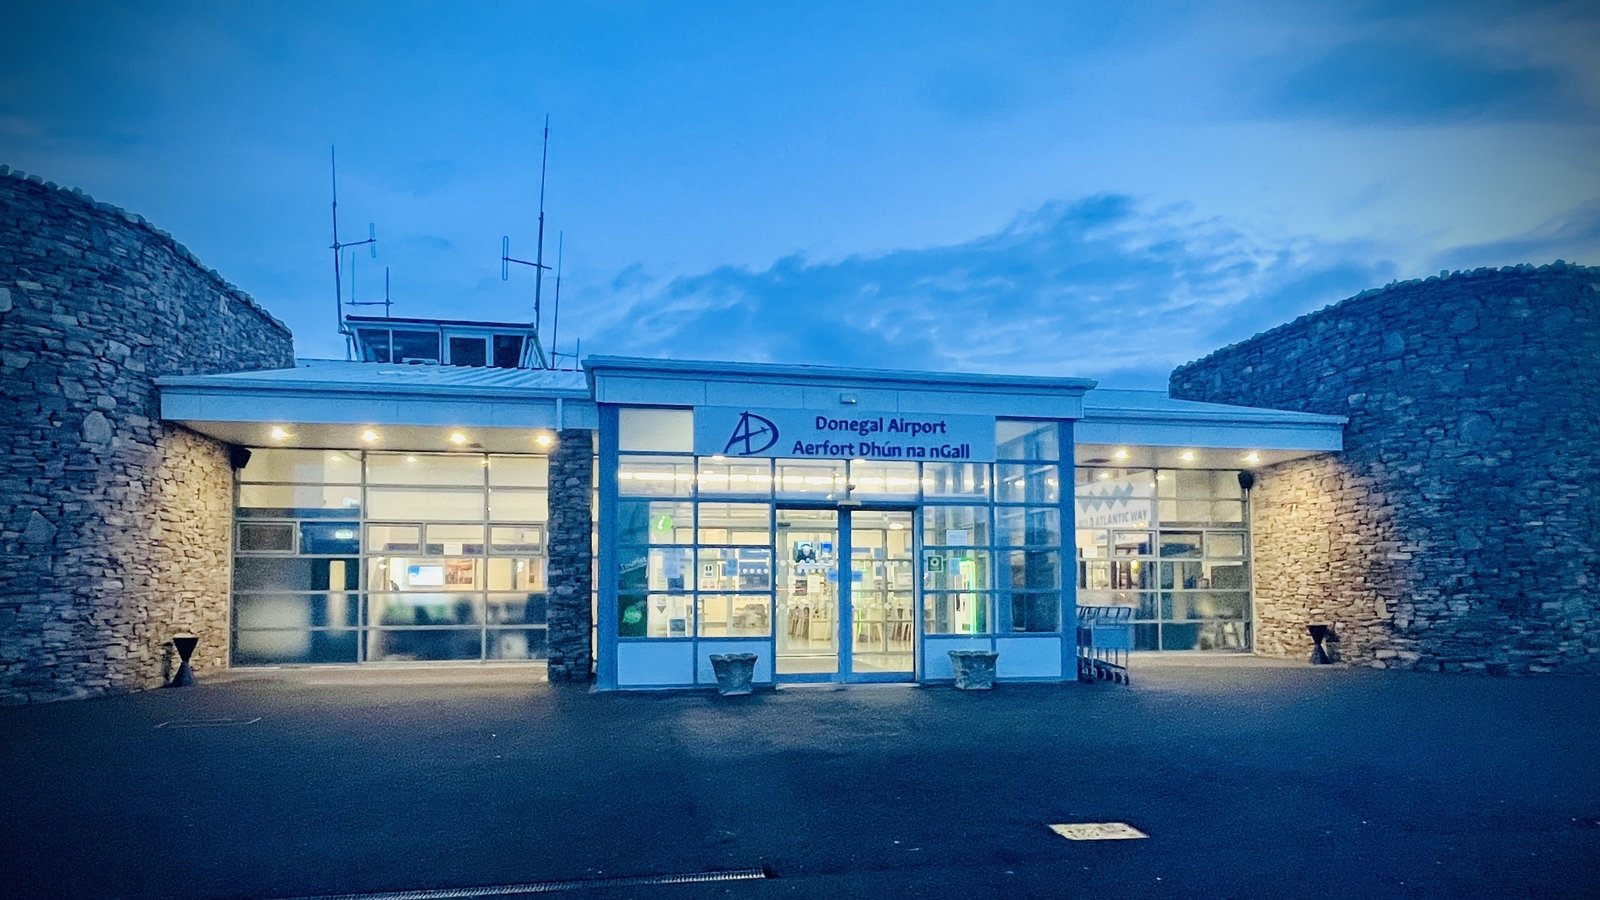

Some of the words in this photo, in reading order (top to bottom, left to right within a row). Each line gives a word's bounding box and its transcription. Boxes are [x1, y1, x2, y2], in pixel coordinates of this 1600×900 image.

[815, 416, 883, 436] Donegal
[888, 418, 946, 437] Airport
[792, 440, 855, 456] Aerfort
[859, 441, 902, 457] Dhún
[906, 445, 926, 458] na
[930, 444, 970, 459] nGall
[1095, 512, 1129, 526] ATLANTIC
[1130, 509, 1147, 521] WAY
